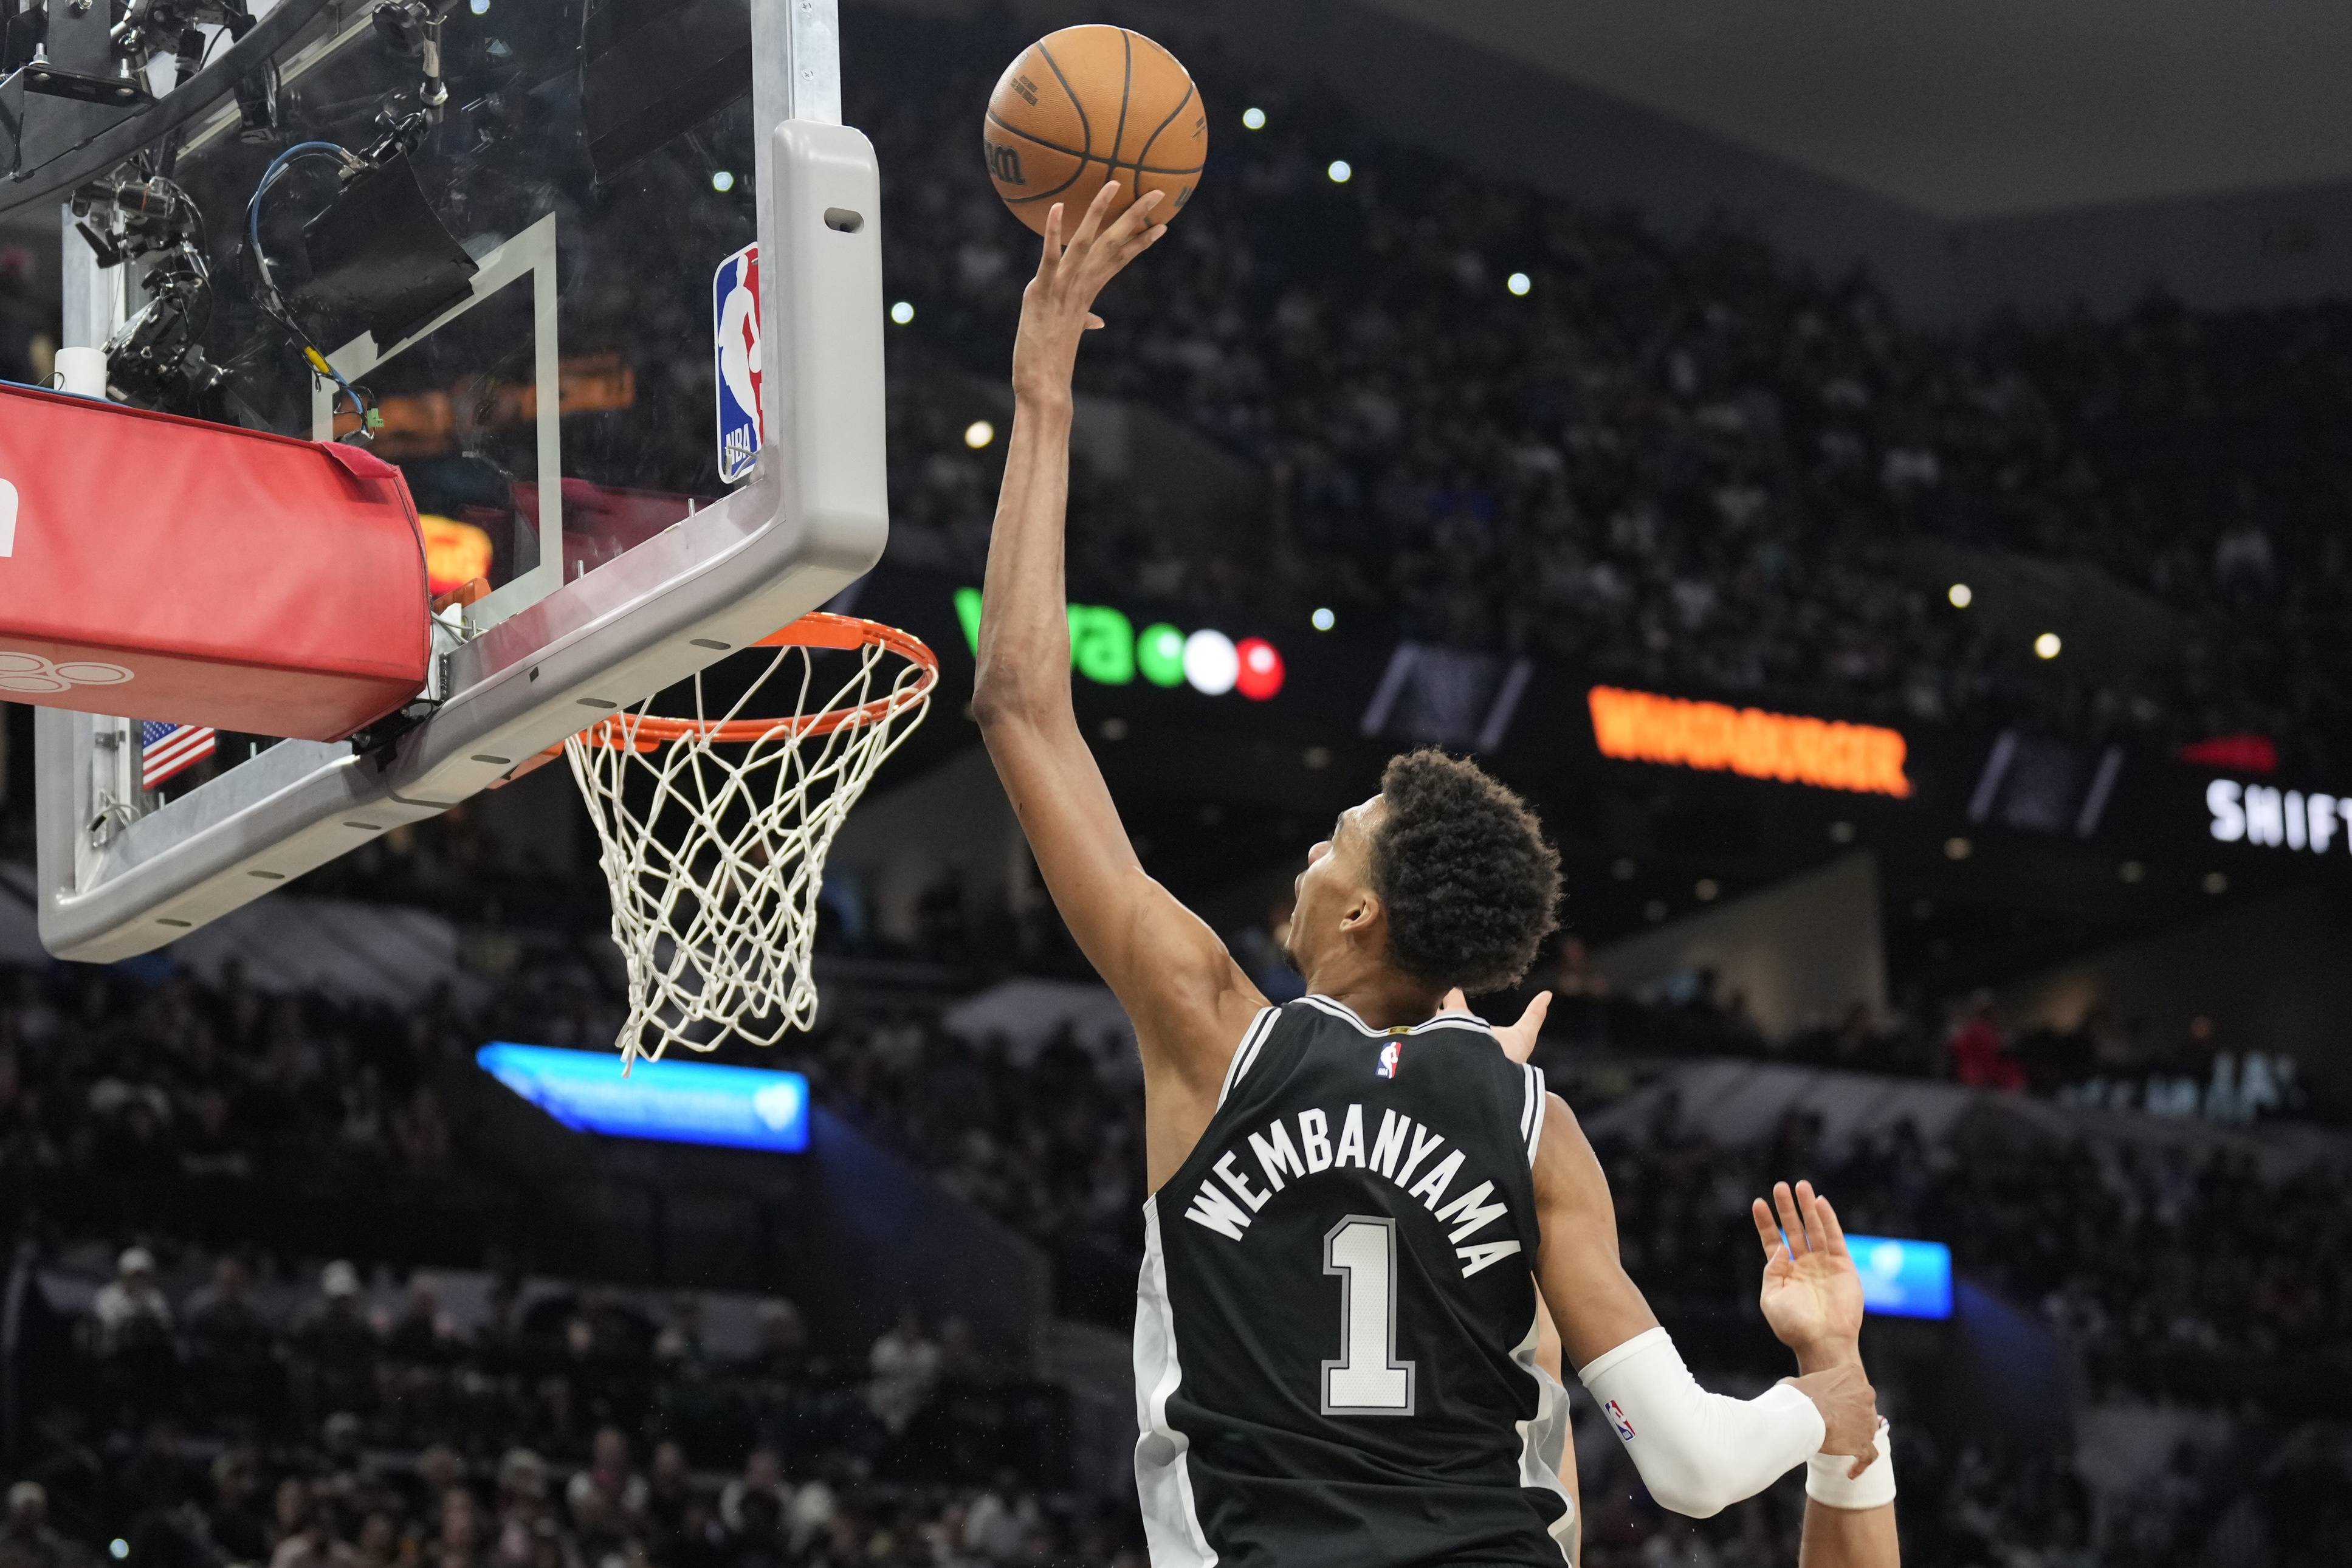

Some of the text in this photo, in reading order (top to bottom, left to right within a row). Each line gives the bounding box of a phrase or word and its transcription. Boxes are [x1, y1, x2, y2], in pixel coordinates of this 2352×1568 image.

[726, 424, 751, 465] NBA
[1185, 1104, 1521, 1279] WEMBANYAMA
[1321, 1214, 1415, 1416] 1
